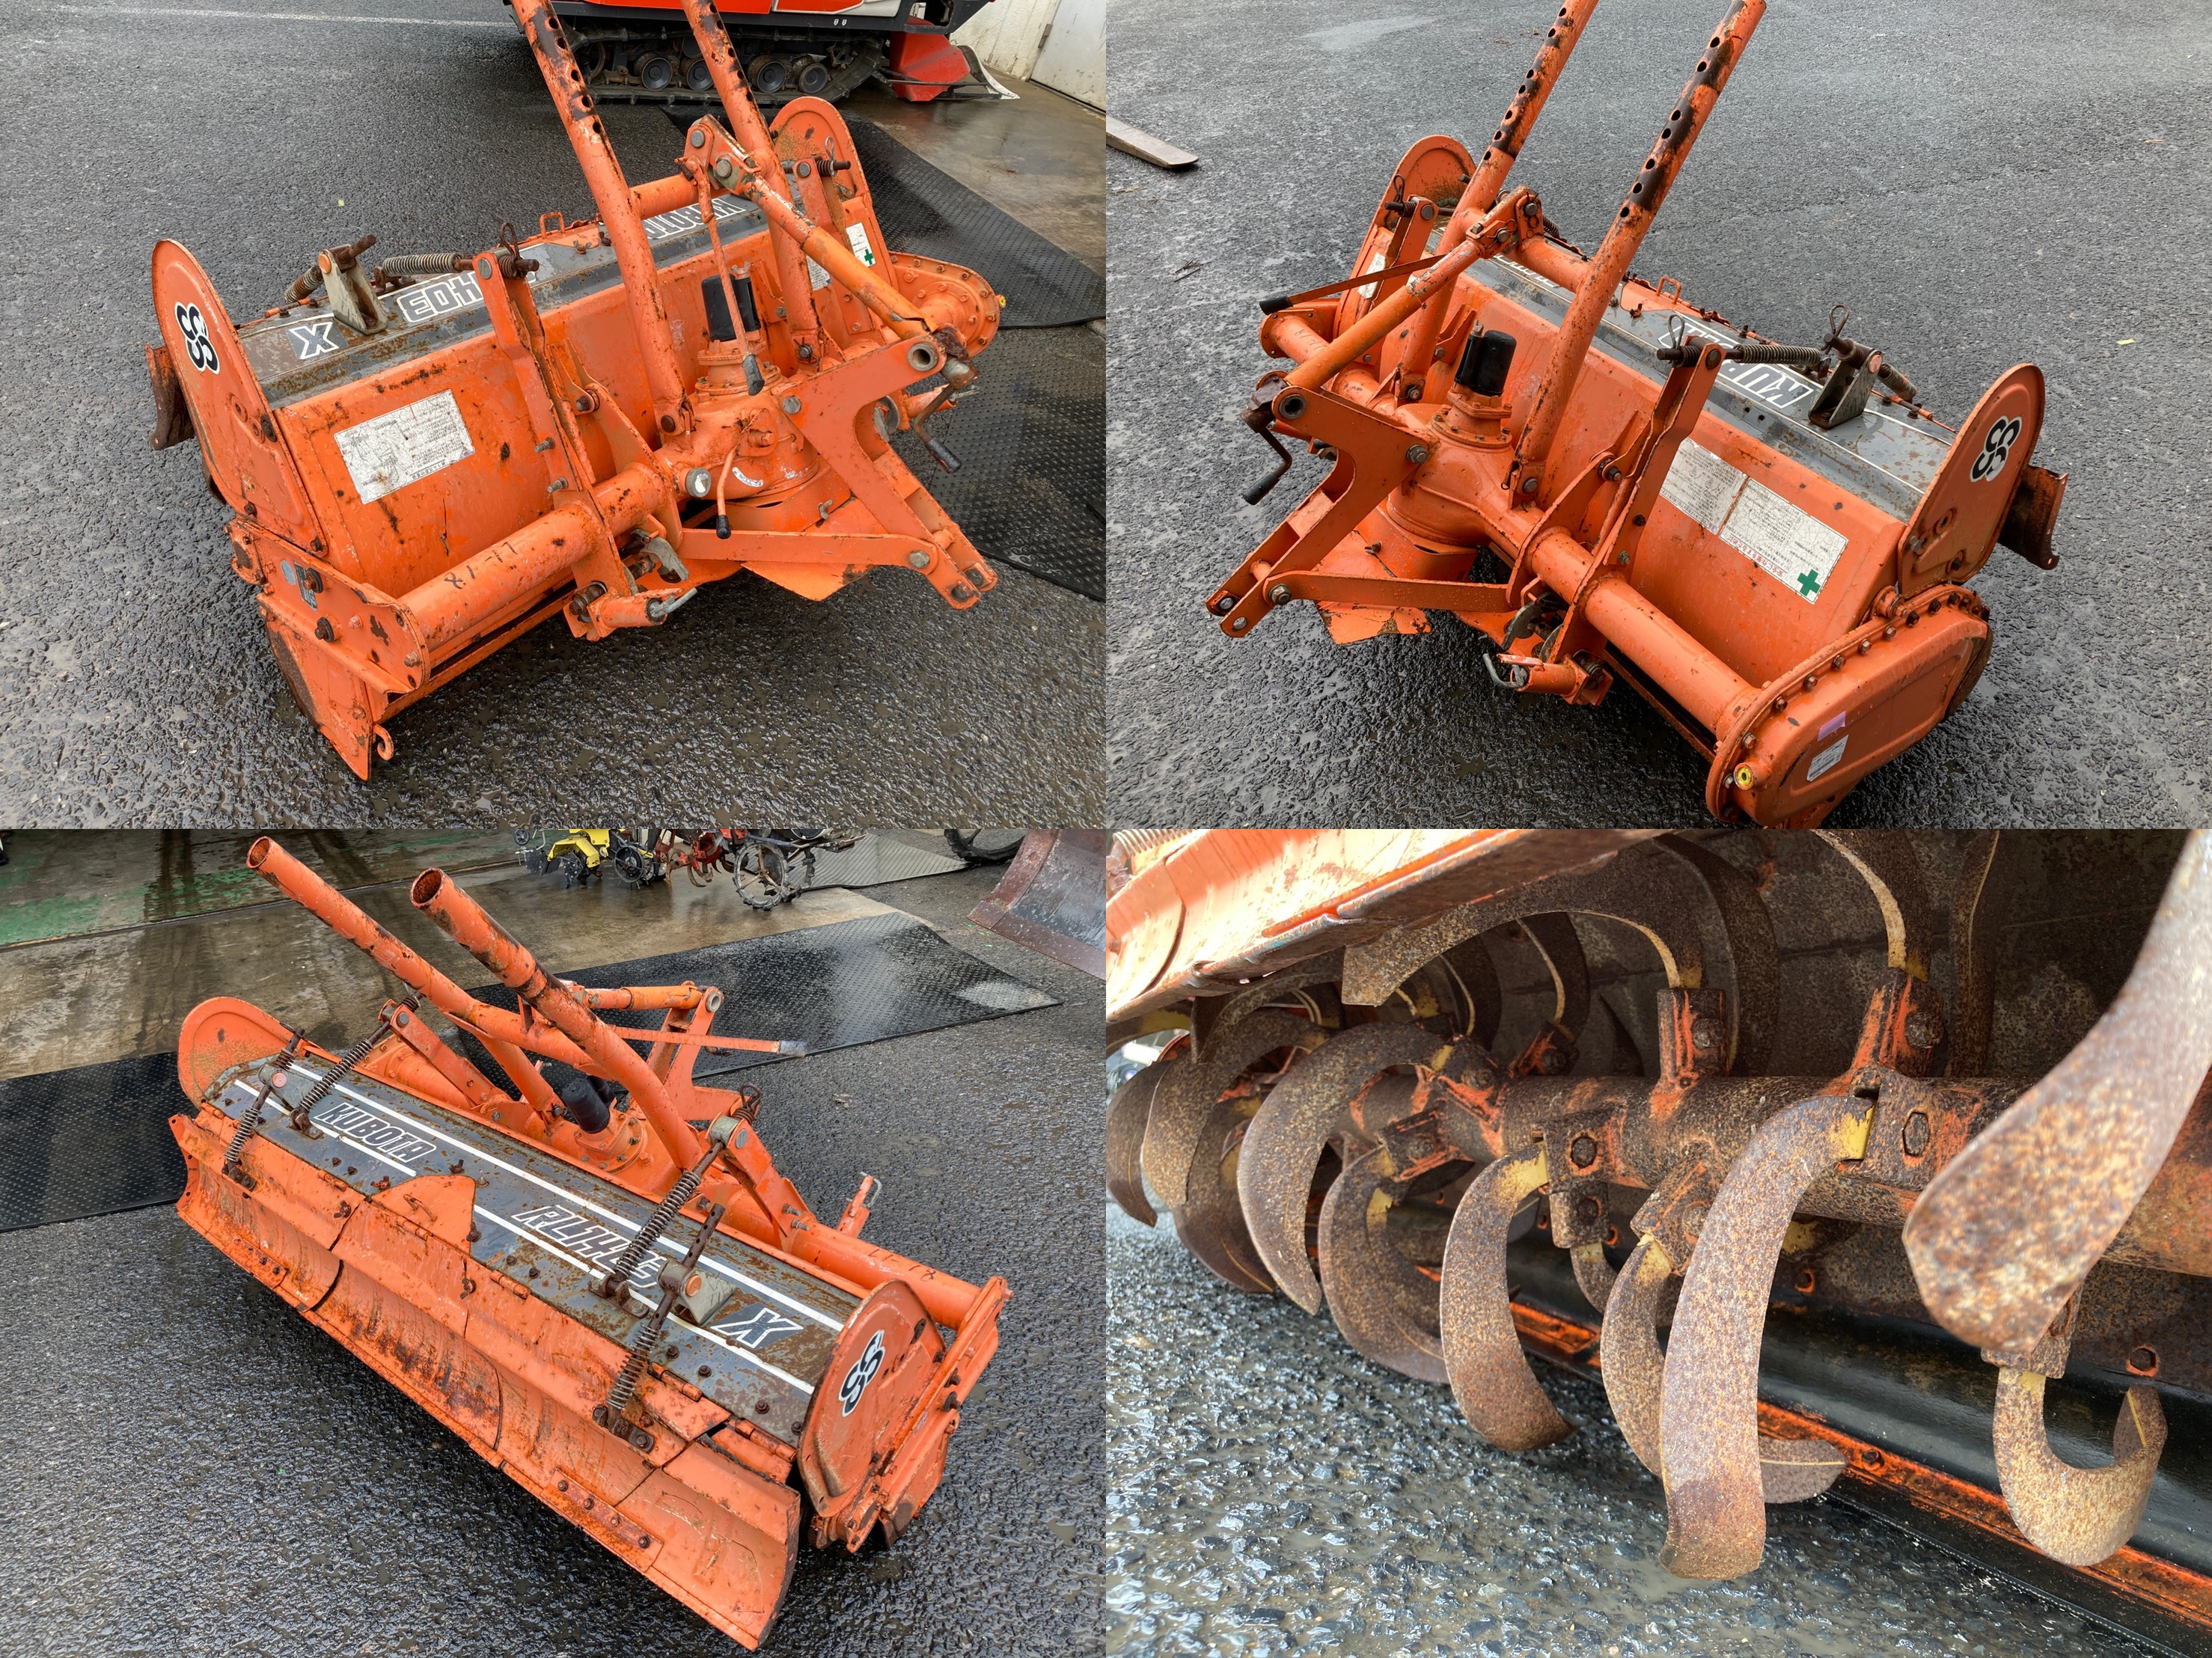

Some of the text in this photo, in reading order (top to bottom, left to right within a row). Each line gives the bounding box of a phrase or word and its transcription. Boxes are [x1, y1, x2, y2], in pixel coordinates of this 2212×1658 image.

[290, 321, 340, 360] X
[1726, 533, 1785, 578] 安全に作業をするために
[313, 1101, 437, 1164] KUBOTA
[710, 1307, 804, 1349] X
